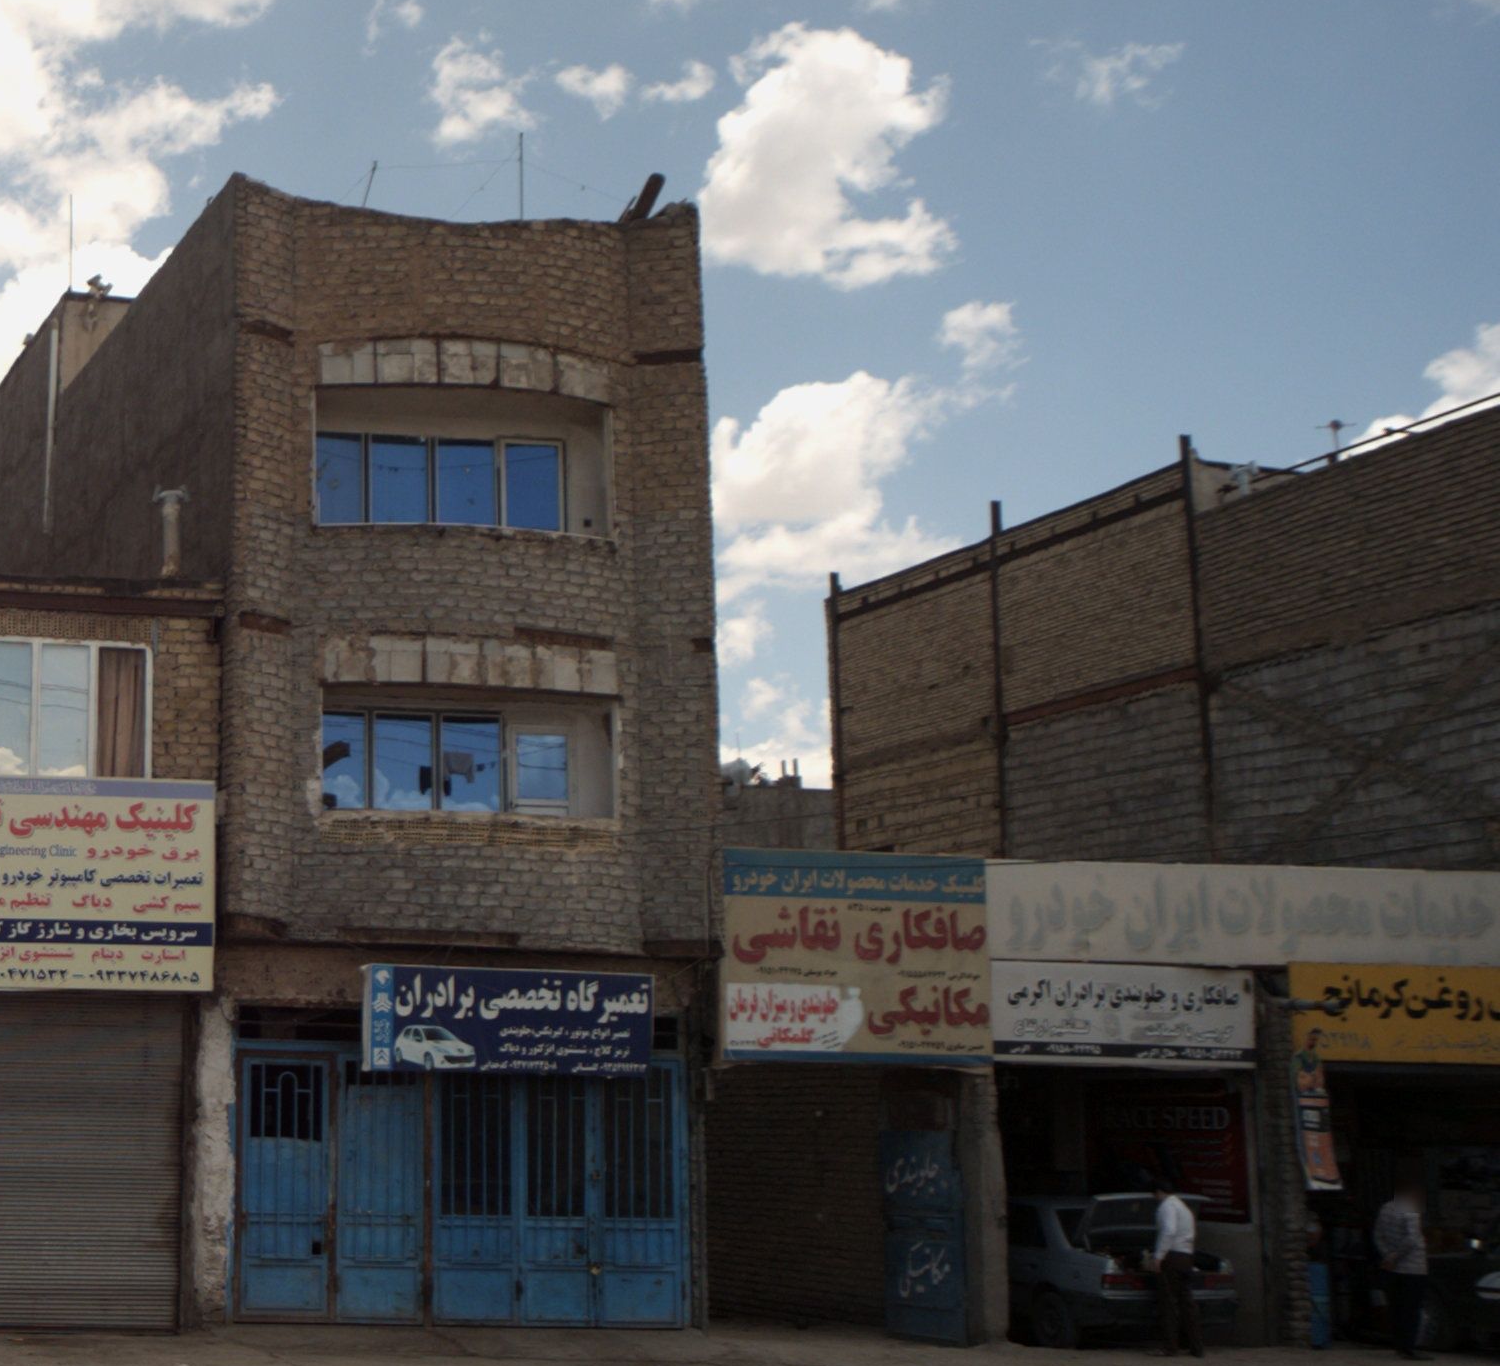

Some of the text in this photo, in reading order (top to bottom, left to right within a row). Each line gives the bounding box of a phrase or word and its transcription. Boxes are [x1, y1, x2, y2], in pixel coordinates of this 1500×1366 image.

[8, 803, 110, 839] مهندسی
[114, 801, 199, 840] کلینیک
[49, 844, 77, 857] Clinic
[85, 845, 201, 861] برق خودرو
[1, 867, 44, 886] خودرو
[781, 868, 819, 894] ایران
[732, 905, 988, 964] صافکاری نقاشی
[394, 972, 475, 1020] برادران
[478, 977, 562, 1021] تخصصی
[867, 985, 991, 1036] مکانیکی
[1405, 975, 1485, 1021] روغن
